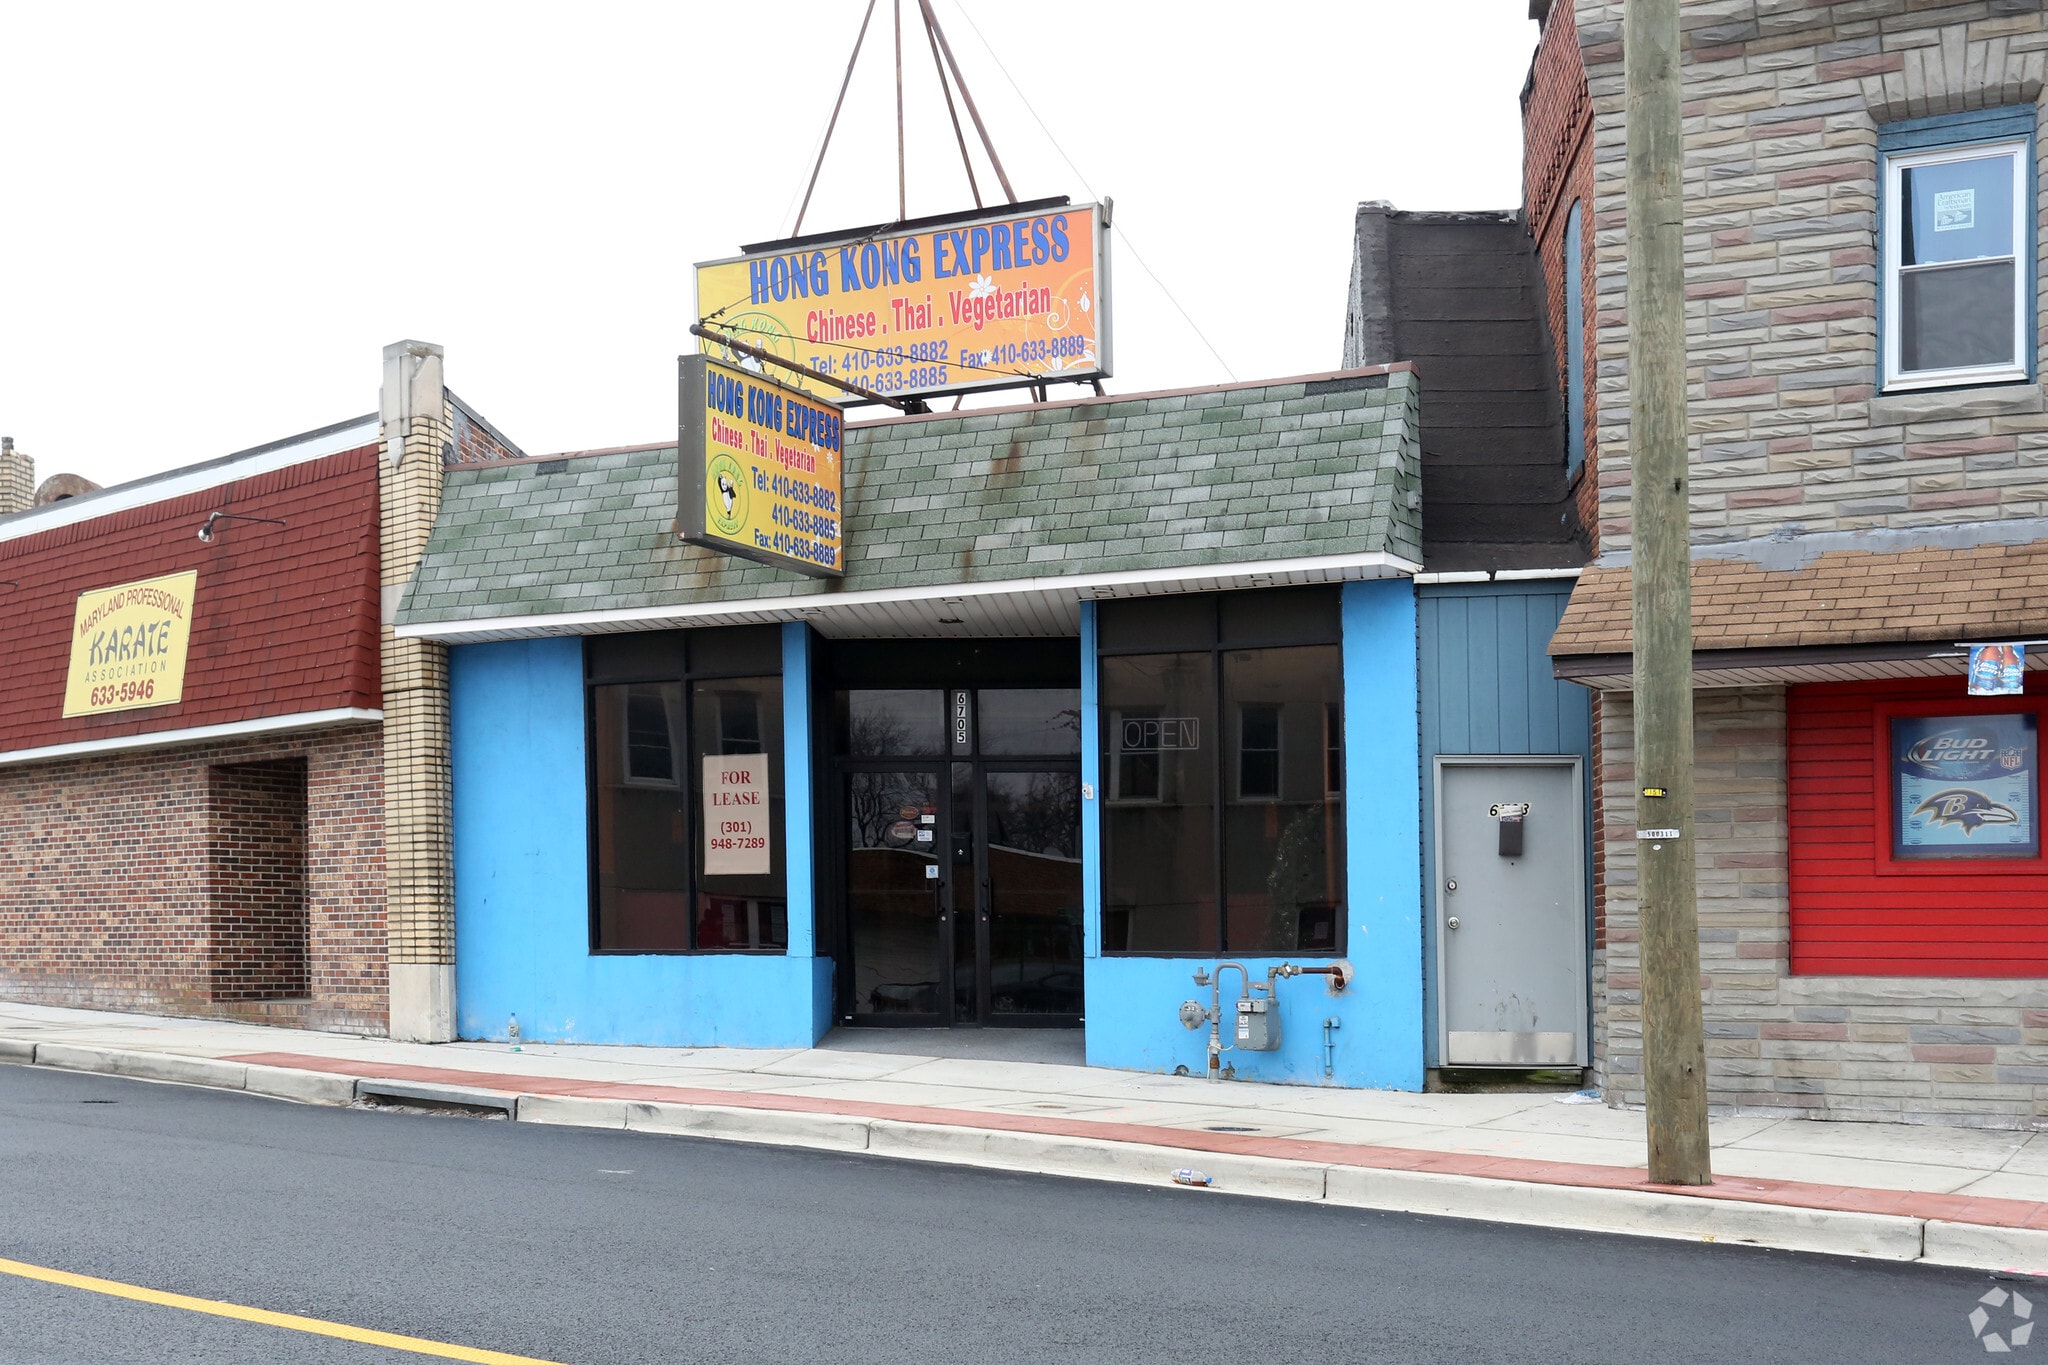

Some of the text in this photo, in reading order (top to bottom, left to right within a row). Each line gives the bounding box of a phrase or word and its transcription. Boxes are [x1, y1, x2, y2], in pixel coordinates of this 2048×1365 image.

[749, 214, 1069, 305] HONG KONG EXPRESS
[806, 308, 876, 344] Chinese
[891, 297, 934, 333] Thai
[949, 281, 1052, 332] Vegetarian
[810, 339, 949, 376] Tel: 410-633-8882
[960, 334, 1085, 370] Fax: 410-633-8889
[708, 370, 840, 452] HONG KONG EXPRESS
[711, 416, 743, 450] Chinese
[750, 430, 768, 460] Thai
[774, 434, 816, 474] Vegetarian
[751, 466, 769, 493] Tel:
[771, 474, 836, 513] 410-633-8882
[771, 503, 836, 541] 410-633-8885
[754, 528, 835, 566] Fax: 410-633-8889
[80, 588, 185, 638] MARYLAND PROFESSIONAL
[89, 620, 171, 667] KARATE
[84, 660, 167, 683] ASSOCIATION
[91, 679, 155, 706] 633-5946
[1124, 720, 1196, 748] OPEN
[1933, 737, 1988, 750] BUD
[1921, 749, 1996, 761] LIGHT
[2002, 756, 2020, 766] NFL
[721, 770, 752, 785] FOR
[712, 791, 761, 806] LEASE
[711, 837, 765, 849] 948-7289
[720, 821, 752, 835] (301)
